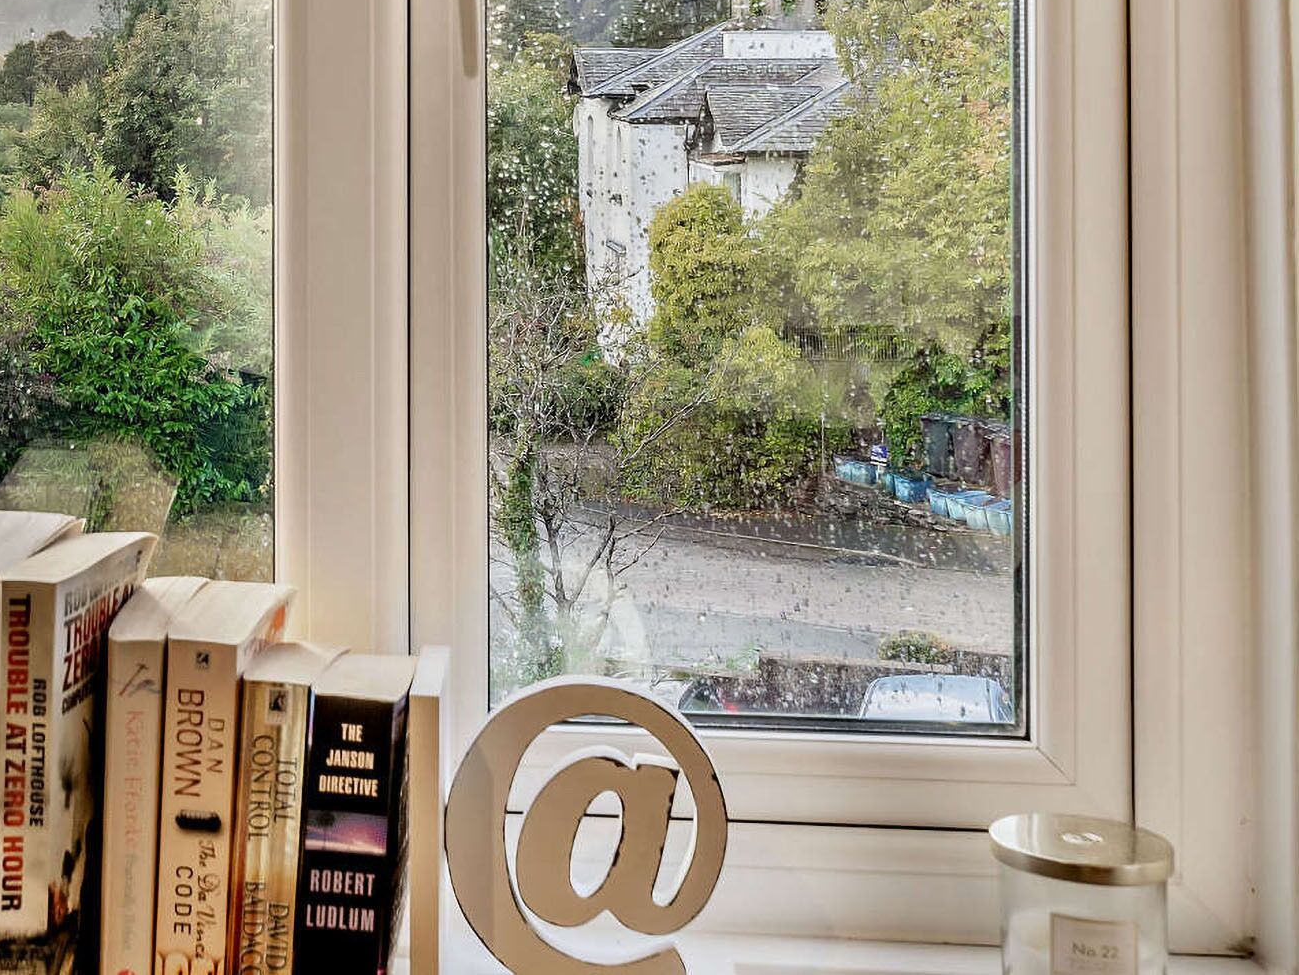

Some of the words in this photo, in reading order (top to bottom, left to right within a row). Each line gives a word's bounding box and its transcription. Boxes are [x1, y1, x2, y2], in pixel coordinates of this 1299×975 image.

[6, 593, 32, 715] TROUBLE
[31, 678, 47, 716] ROB
[5, 719, 28, 755] AT
[174, 689, 205, 797] BROWN
[206, 718, 225, 773] DAN
[325, 748, 375, 770] JANSON
[340, 722, 363, 743] THE
[2, 759, 27, 832] ZERO
[29, 721, 45, 827] LOFTHOUSE
[247, 735, 274, 842] CONTROL
[274, 757, 298, 823] TOTAL
[318, 773, 379, 798] DIRECTIVE
[1, 836, 25, 911] HOUR
[197, 840, 217, 867] The
[174, 866, 194, 935] CODE
[195, 873, 221, 903] Da
[310, 868, 376, 897] ROBERT
[194, 905, 217, 960] Vinci
[240, 881, 267, 975] BALDACC
[265, 903, 291, 970] DAVID
[306, 904, 375, 933] LUDLUM
